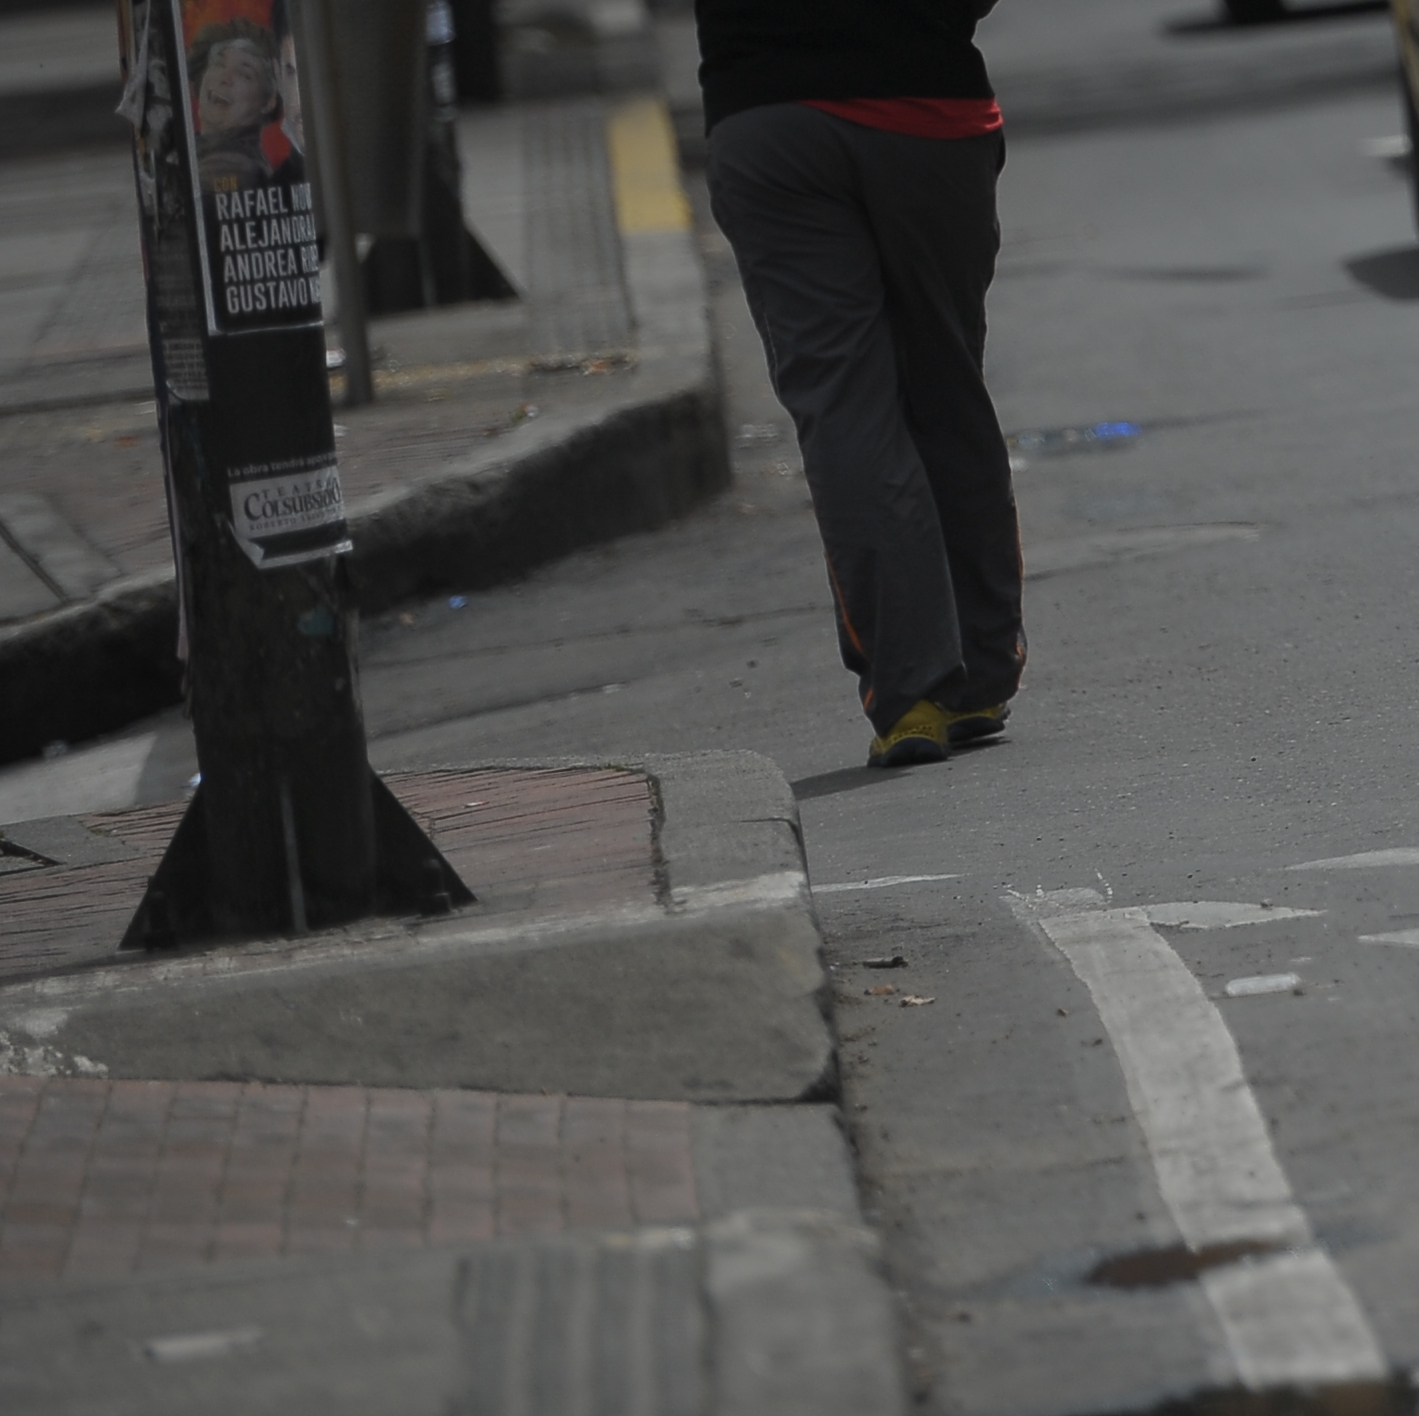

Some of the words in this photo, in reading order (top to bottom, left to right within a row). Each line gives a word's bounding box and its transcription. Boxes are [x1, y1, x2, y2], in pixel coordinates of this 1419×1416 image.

[212, 175, 238, 192] CON
[214, 185, 290, 221] RAFAEL
[219, 215, 310, 253] ALEJANDRA
[223, 248, 297, 285] ANDREA
[226, 279, 309, 317] GUSTAVO
[227, 468, 241, 478] La
[243, 462, 269, 475] obra
[244, 477, 342, 522] COLSUBSIDIO
